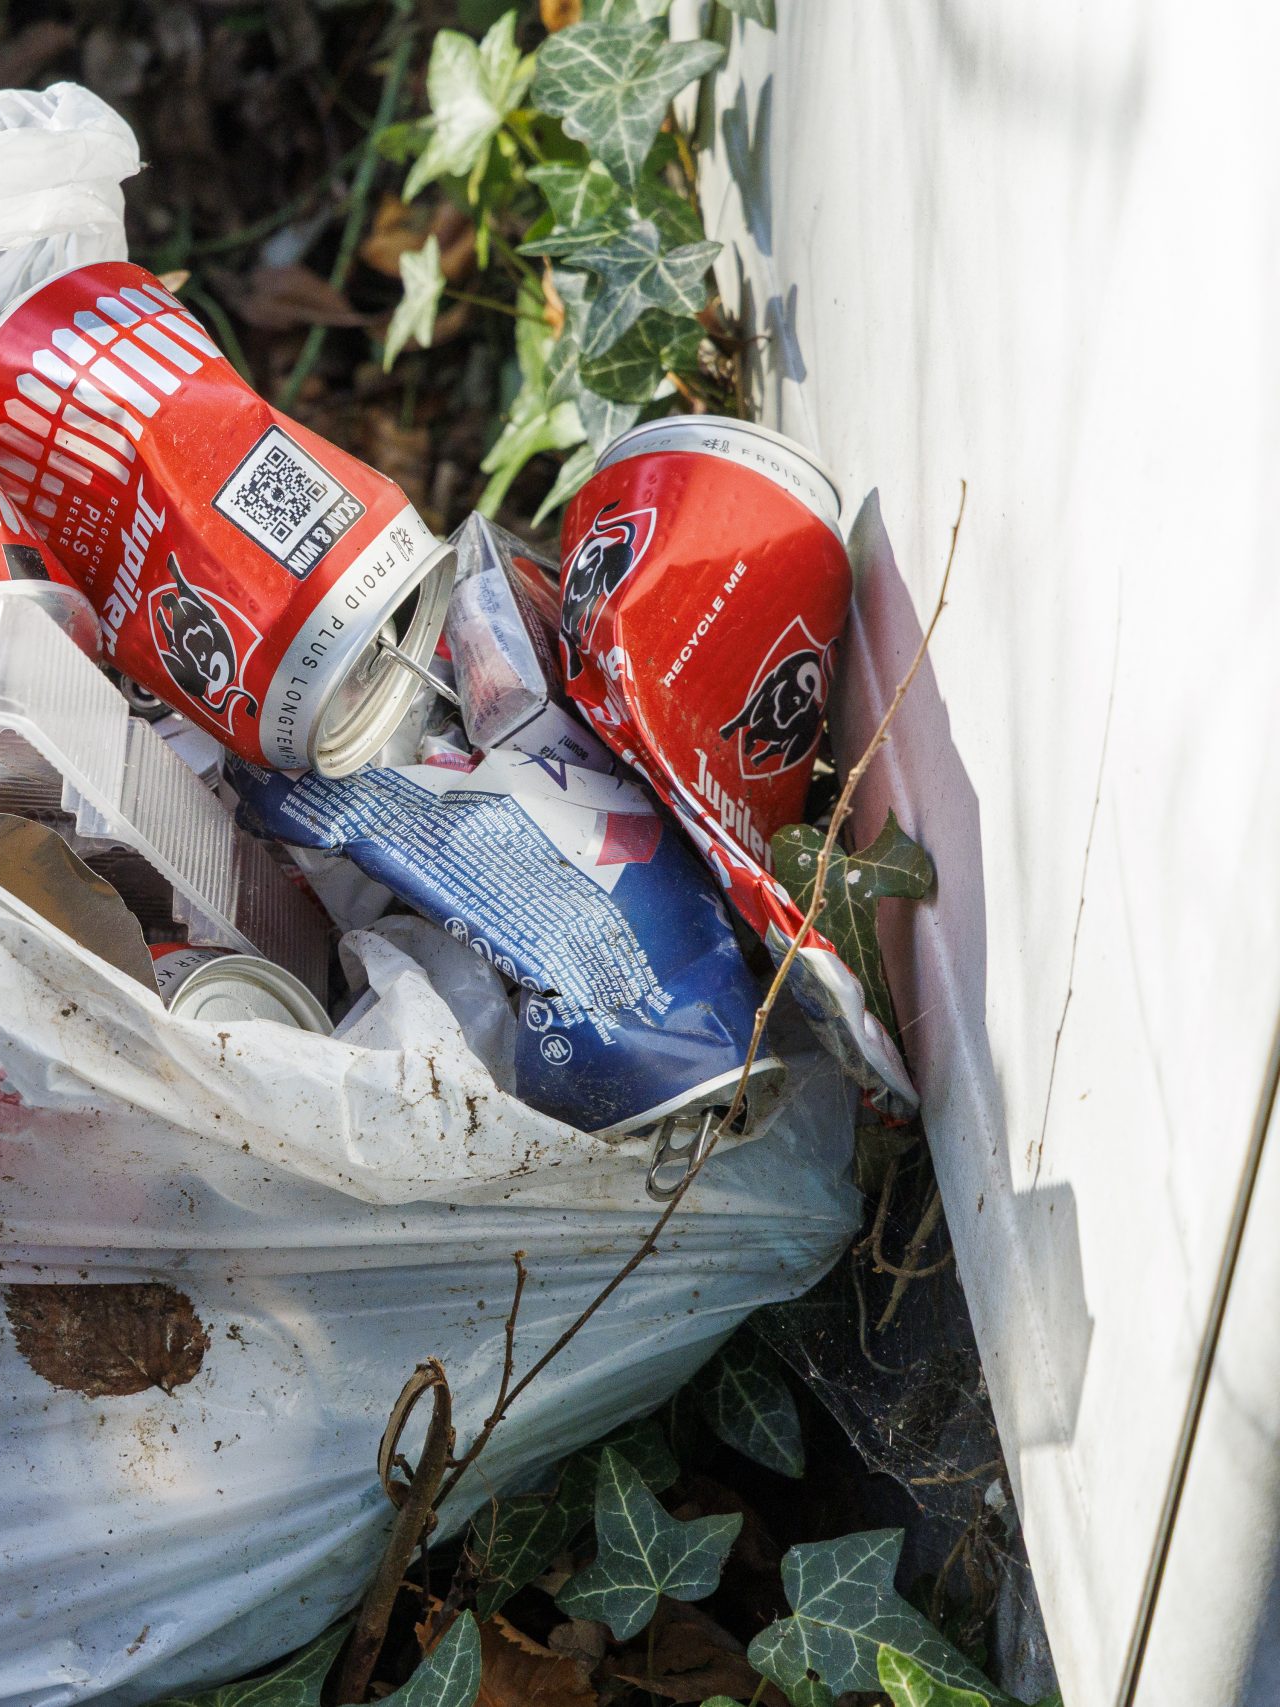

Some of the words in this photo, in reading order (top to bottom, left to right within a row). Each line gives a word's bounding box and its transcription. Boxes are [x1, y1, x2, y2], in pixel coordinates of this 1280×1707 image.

[741, 447, 802, 487] FROID
[59, 495, 82, 547] BELGE
[72, 503, 102, 557] PILS
[85, 496, 119, 586] BELGISCHE
[312, 526, 332, 545] &
[322, 496, 361, 535] SCAN
[100, 473, 166, 657] Jupiler
[287, 539, 323, 575] WIN
[345, 551, 396, 610] FROID
[302, 615, 345, 670] PLUS
[663, 595, 726, 688] RECYCLE
[723, 560, 748, 594] ME
[276, 676, 308, 769] LONGTEMPS
[557, 735, 590, 761] acum!
[285, 792, 348, 844] www.responsibledrink
[300, 775, 312, 786] ver
[309, 781, 328, 798] base.
[324, 792, 361, 826] Entreposer
[384, 844, 392, 854] y
[389, 848, 409, 865] seco.
[343, 825, 355, 837] en
[478, 801, 509, 836] sulphites.
[432, 825, 451, 843] Bière
[447, 838, 479, 867] importée
[475, 862, 486, 873] et
[513, 896, 524, 906] au
[522, 903, 544, 923] Maroc
[540, 920, 555, 933] par
[483, 833, 526, 876] Naturalmente
[523, 871, 553, 897] contiene
[512, 809, 551, 852] Ingrédients:
[611, 907, 622, 918] de
[348, 797, 363, 812] and
[359, 806, 379, 825] best
[389, 832, 404, 846] sec
[401, 841, 411, 851] et
[408, 845, 446, 880] frais/Store
[442, 874, 452, 884] in
[452, 882, 471, 900] cool,
[466, 894, 482, 910] dry
[564, 995, 586, 1024] helyen
[410, 822, 438, 846] Moumen
[439, 844, 478, 879] Casablanca,
[475, 874, 500, 897] Maroc.
[497, 892, 515, 910] Date
[512, 906, 522, 916] de
[518, 912, 557, 947] production
[562, 955, 572, 965] et
[434, 854, 490, 902] preferentemente
[486, 897, 506, 916] antes
[503, 911, 517, 924] del
[513, 919, 527, 932] fin
[534, 937, 551, 953] Voir
[547, 951, 564, 970] sous
[495, 803, 522, 835] sulfites.
[633, 967, 651, 993] syrup,
[645, 992, 667, 1015] wheat,
[567, 921, 594, 960] Carlsberg
[585, 919, 602, 941] agua,
[544, 1039, 569, 1059] 18+
